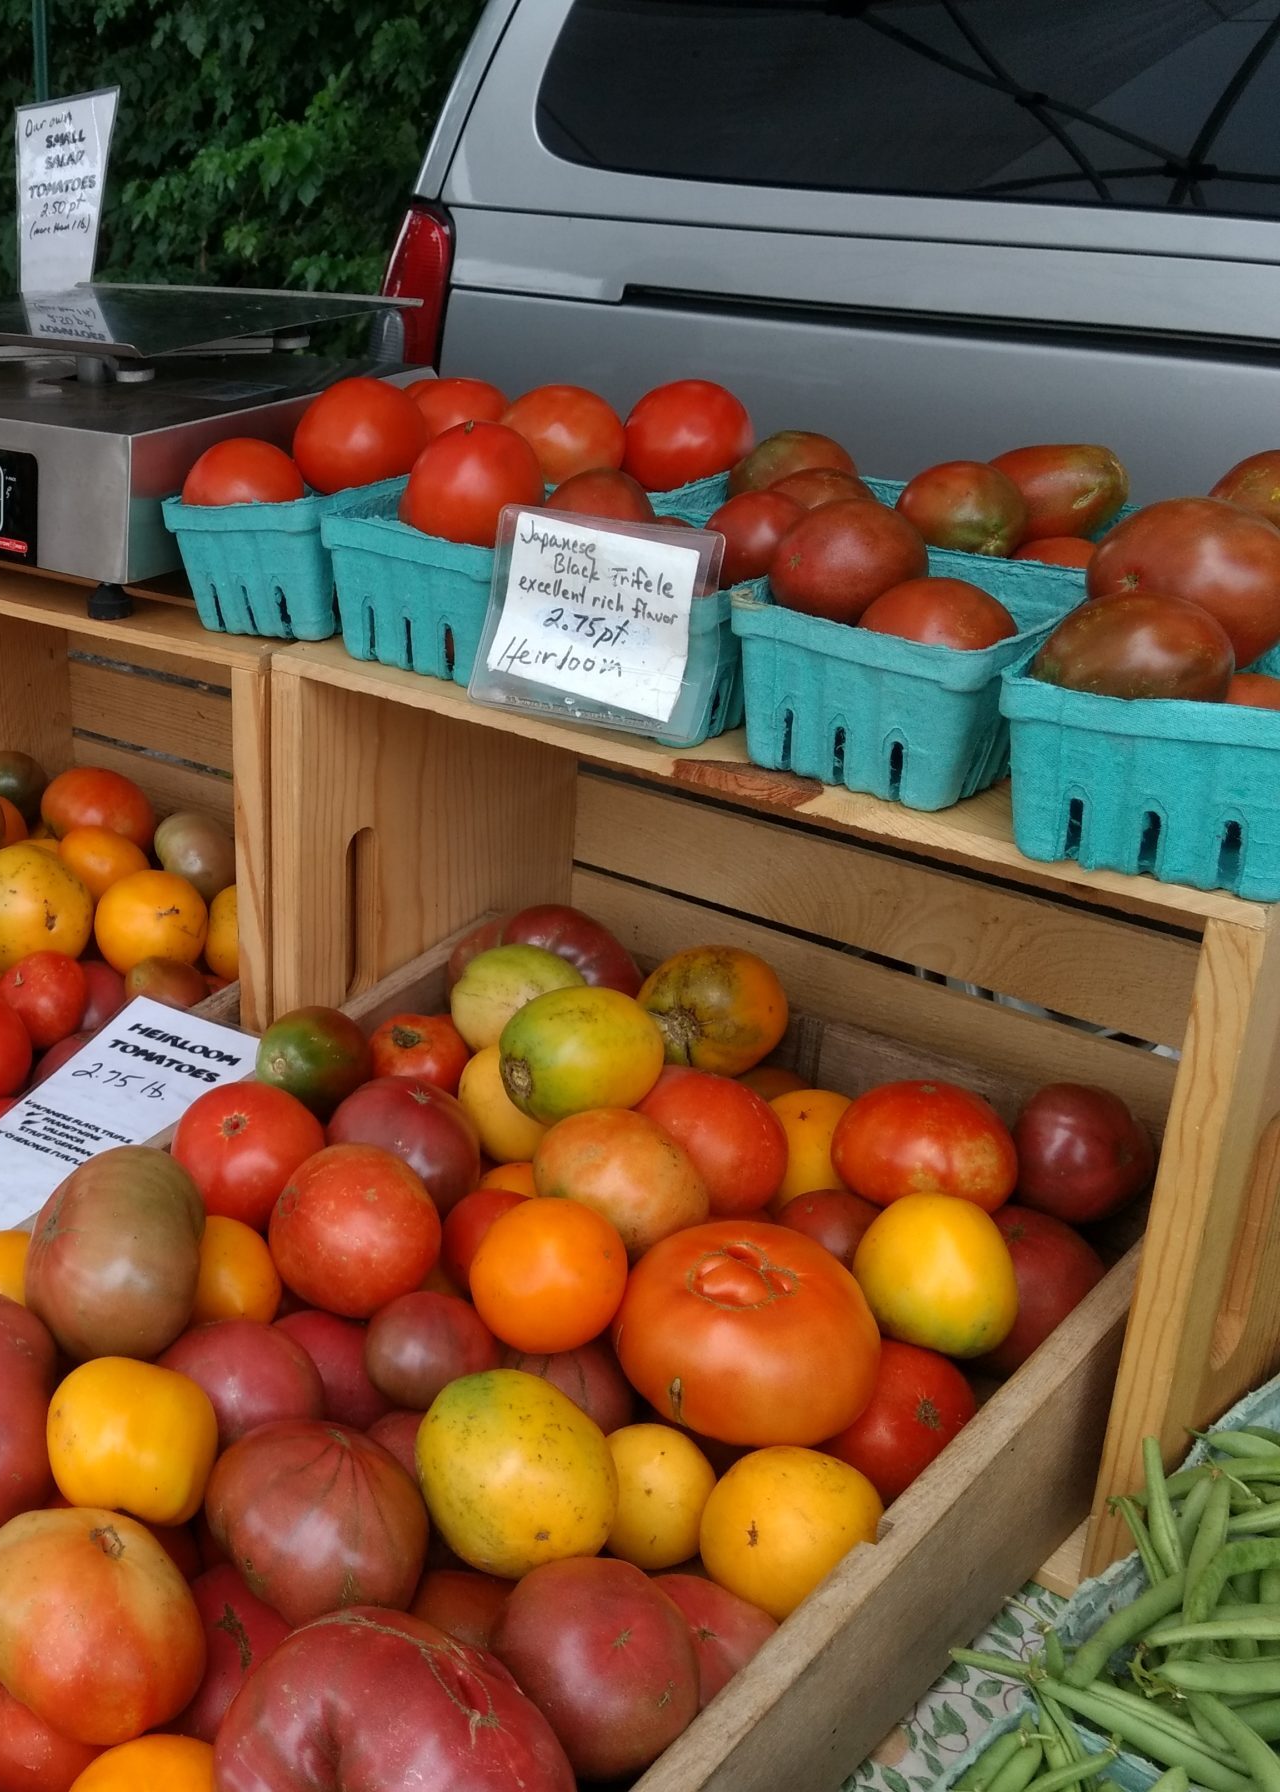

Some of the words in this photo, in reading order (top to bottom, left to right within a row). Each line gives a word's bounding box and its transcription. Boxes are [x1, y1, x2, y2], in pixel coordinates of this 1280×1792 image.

[45, 129, 86, 149] SMALL
[44, 150, 85, 170] SALAD
[28, 174, 97, 199] TOMATOES
[40, 200, 65, 218] 2.50
[520, 520, 596, 560] Japanese
[553, 553, 600, 583] Black
[610, 566, 675, 599] Trifele
[518, 575, 586, 604] excellent
[591, 592, 625, 614] rich
[631, 598, 680, 626] flavor
[497, 636, 623, 678] Heirloom
[107, 1038, 221, 1083] TOMATOES
[127, 1022, 242, 1067] HEIRLOOM
[71, 1062, 145, 1088] 2.75
[140, 1080, 166, 1100] lb.
[4, 1132, 51, 1154] CHEROKEE
[42, 1116, 104, 1142] BRANDYWINE
[42, 1124, 86, 1144] VALENCIA
